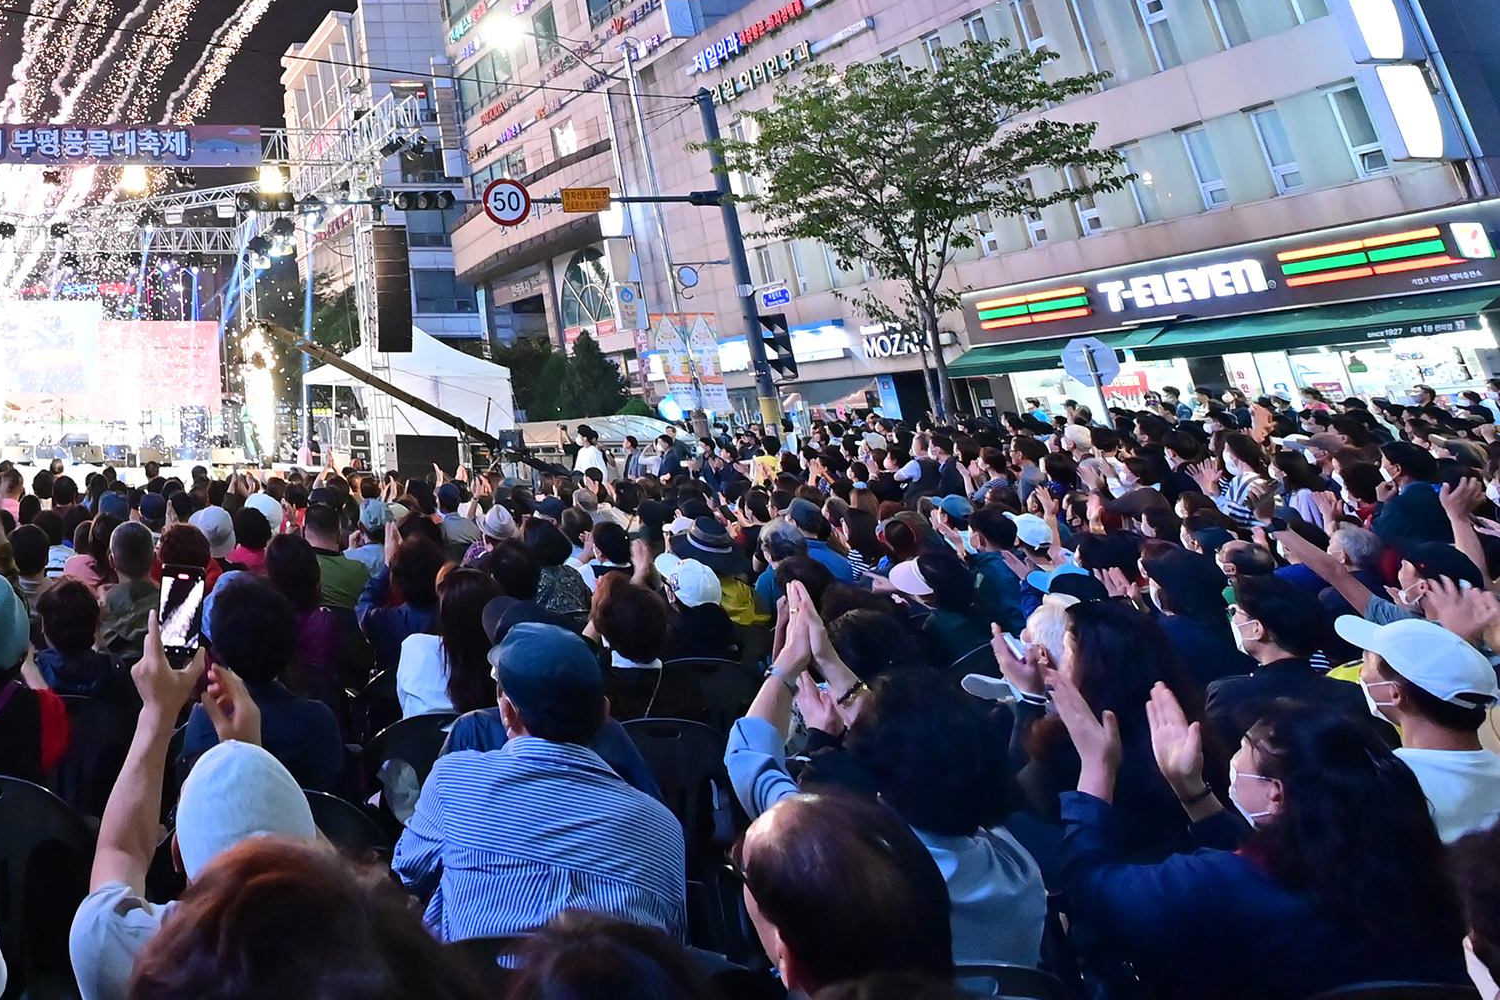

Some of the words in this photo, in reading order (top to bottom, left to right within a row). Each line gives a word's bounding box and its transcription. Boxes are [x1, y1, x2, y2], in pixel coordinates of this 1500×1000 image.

[693, 32, 740, 73] 제일외과
[739, 39, 813, 91] 이비인후과
[12, 129, 188, 157] 부평풍물대축제
[493, 191, 520, 211] 50
[1236, 370, 1250, 394] 와인
